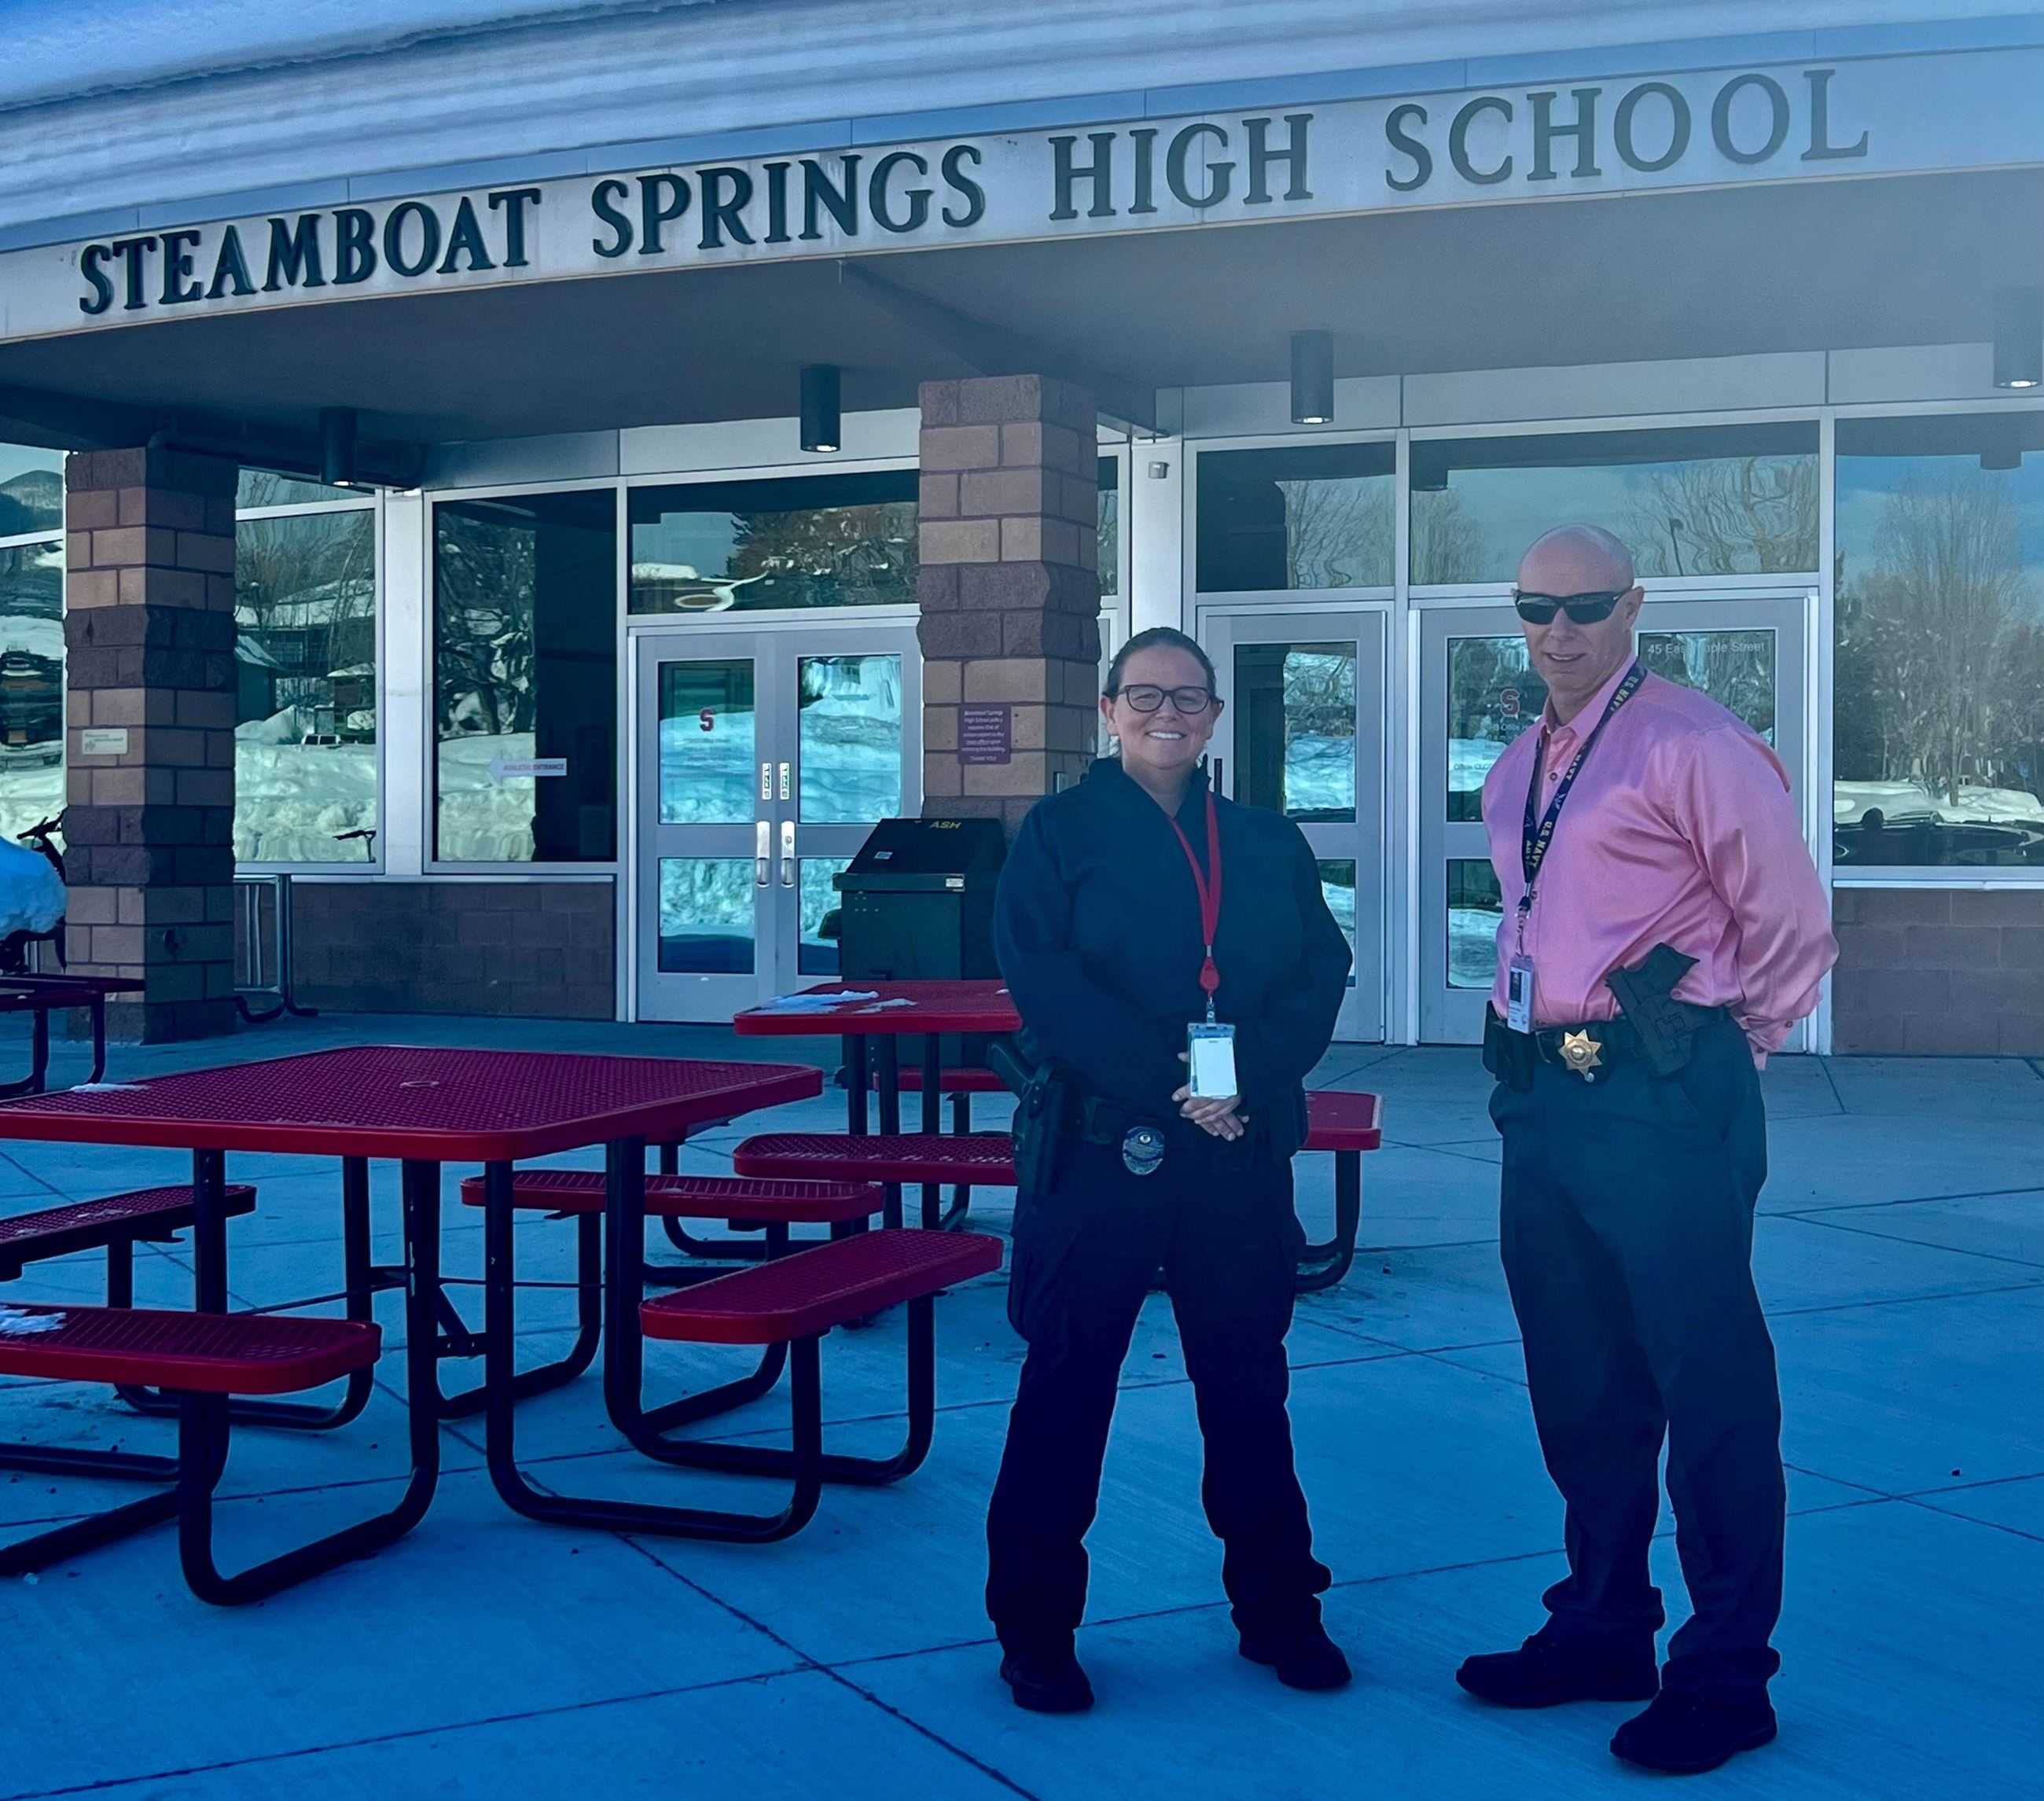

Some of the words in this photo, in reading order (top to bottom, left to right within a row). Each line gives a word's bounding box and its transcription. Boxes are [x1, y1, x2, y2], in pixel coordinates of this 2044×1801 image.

[79, 188, 541, 314] STEAMBOAT
[593, 145, 986, 259] SPRINGS
[1048, 114, 1314, 220] HIGH
[1385, 69, 1869, 191] SCHOOL
[1648, 644, 1662, 654] 45
[1665, 643, 1689, 653] Eas
[1730, 641, 1765, 652] Street
[1500, 689, 1520, 717] S
[699, 708, 714, 732] S
[928, 821, 961, 829] ASH
[1539, 821, 1553, 837] U.S.
[1531, 840, 1546, 868] NAVY
